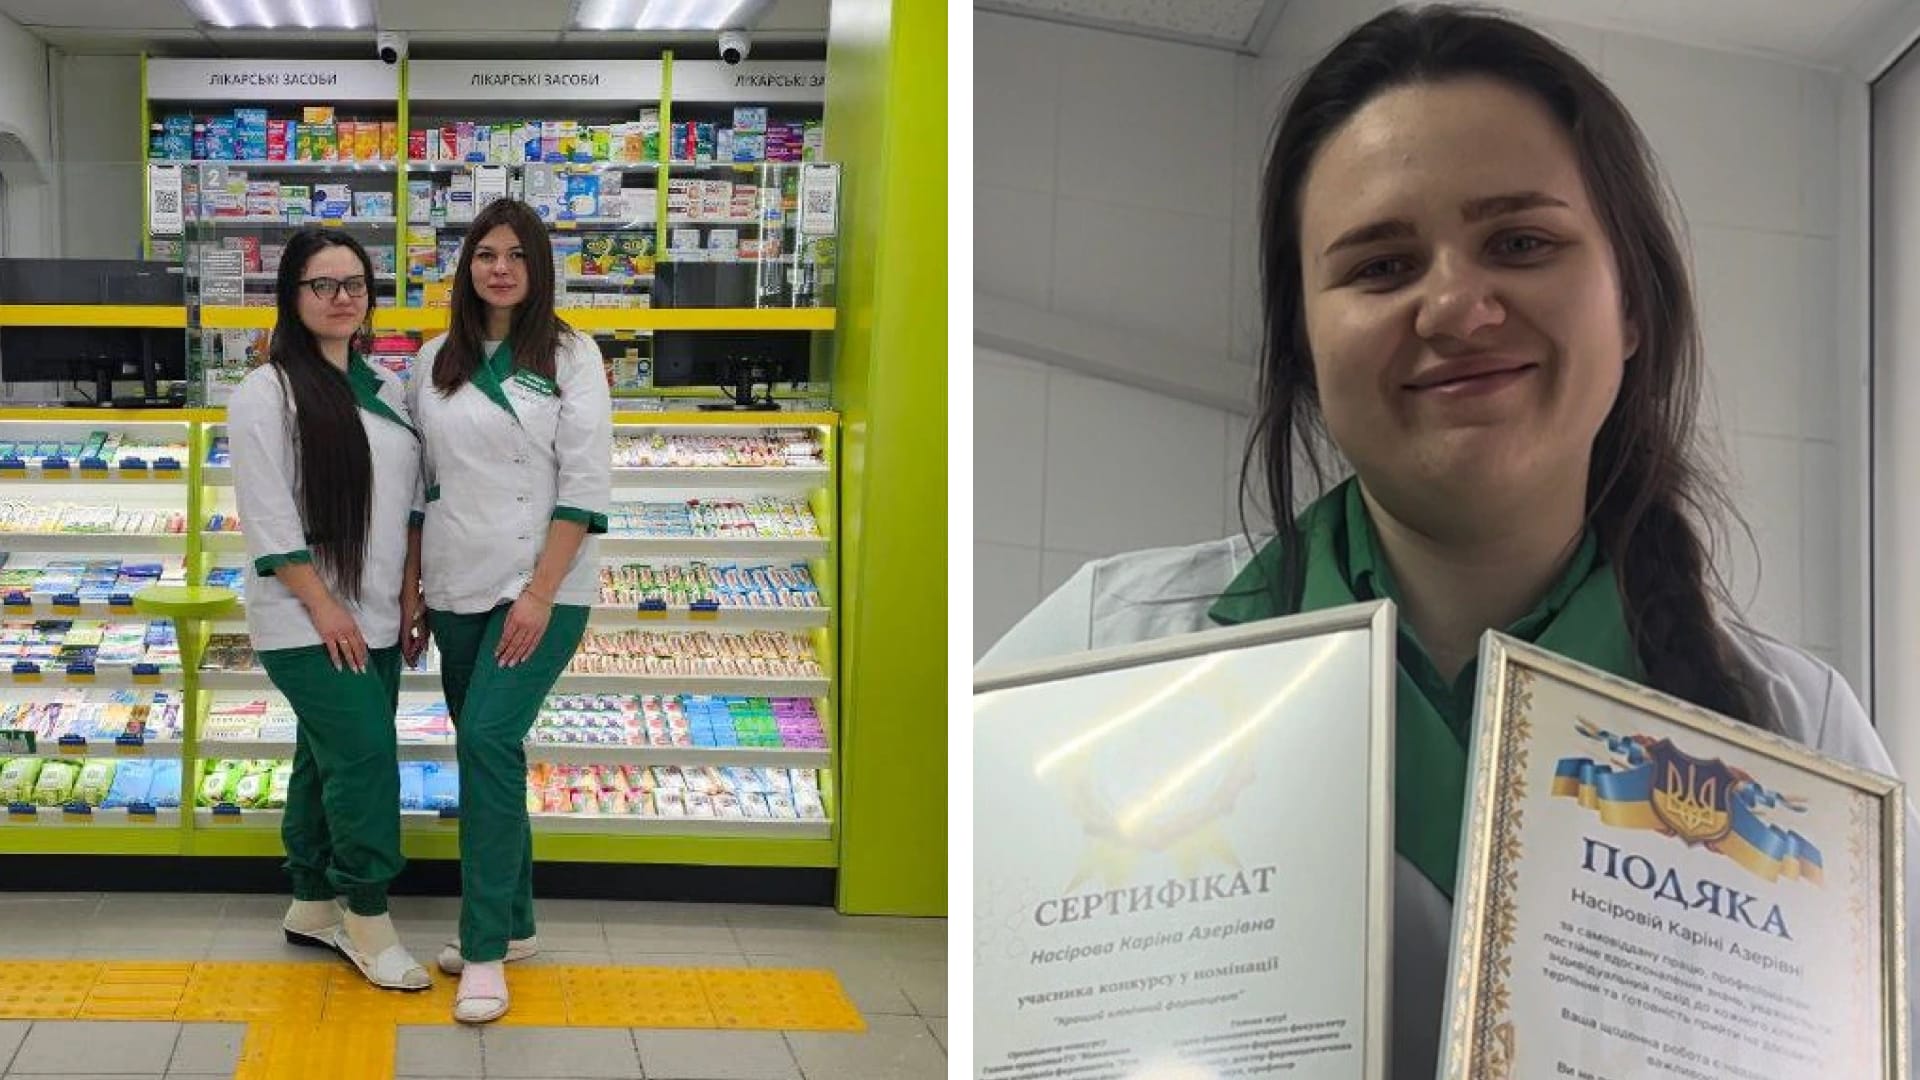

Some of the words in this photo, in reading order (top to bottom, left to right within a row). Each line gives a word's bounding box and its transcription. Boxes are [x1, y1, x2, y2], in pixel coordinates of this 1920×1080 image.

[208, 73, 279, 86] ЛІКАРСЬКІ
[282, 73, 338, 86] ЗАСОБИ
[471, 73, 541, 86] ЛІКАРСЬКІ
[544, 73, 600, 86] ЗАСОБИ
[207, 169, 221, 187] 2
[1033, 865, 1277, 928] СЕРТИФІКАТ
[1581, 836, 1794, 942] ПОДЯКА
[1029, 941, 1114, 966] Насірова
[1119, 930, 1184, 952] Каріна
[1187, 916, 1277, 942] Азерівна
[1570, 887, 1664, 932] Насіровій
[1667, 919, 1724, 952] Каріні
[1728, 941, 1804, 977] Азерівні
[1576, 926, 1660, 963] самовіддану
[1016, 986, 1095, 1010] учасника
[1099, 974, 1177, 994] конкурсу
[1179, 972, 1190, 985] у
[1193, 955, 1281, 981] номінації
[1542, 932, 1602, 959] постійне
[1603, 953, 1704, 993] вдосконалення
[1542, 966, 1601, 993] терпіння
[1602, 987, 1618, 1000] та
[1621, 992, 1692, 1025] готовність
[1652, 985, 1691, 1009] підхід
[1693, 1000, 1711, 1014] до
[1560, 1007, 1598, 1030] Ваша
[1599, 1022, 1661, 1050] щоденна
[1661, 1042, 1711, 1066] робота
[1556, 1060, 1575, 1076] Ви
